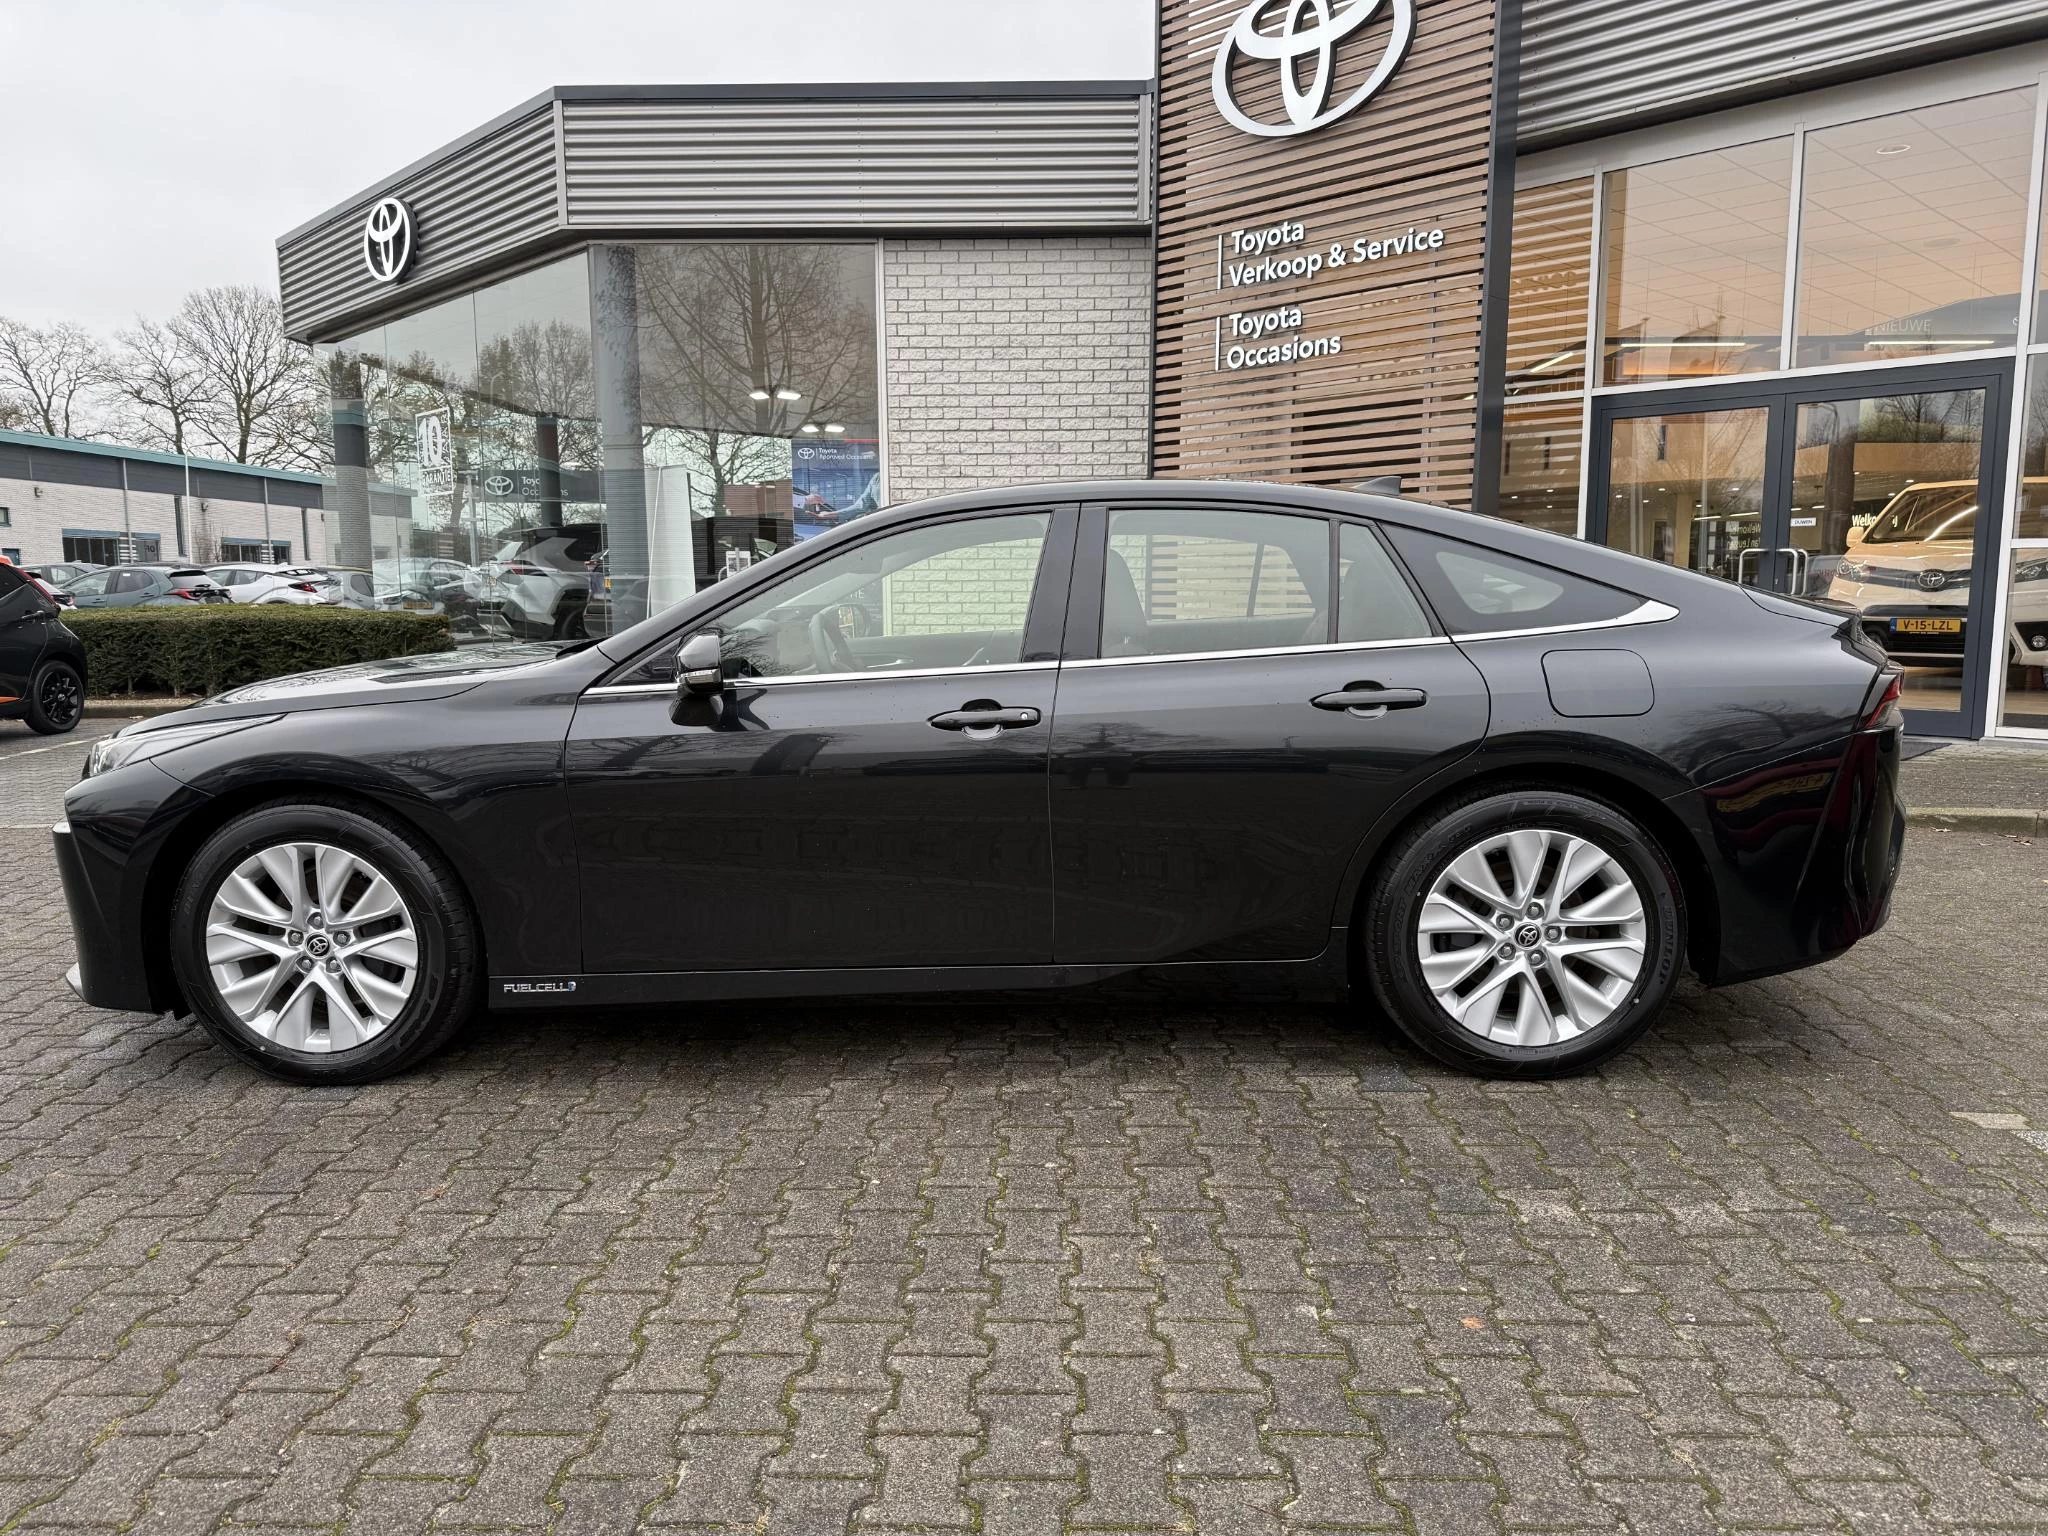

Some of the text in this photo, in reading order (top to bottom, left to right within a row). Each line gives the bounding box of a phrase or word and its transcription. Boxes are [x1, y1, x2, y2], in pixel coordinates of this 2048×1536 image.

[1231, 221, 1305, 256] Toyota
[1229, 227, 1444, 287] Verkoop & Service
[1229, 306, 1302, 338] Toyota
[1875, 319, 1932, 332] NIEUWE
[1226, 335, 1341, 369] Occasions
[418, 414, 443, 468] 10
[819, 447, 837, 455] Toyota
[521, 476, 540, 486] Toyo
[521, 487, 569, 497] Occns
[1851, 512, 1877, 527] Welko
[1903, 620, 1953, 631] V-15-LZL
[1659, 905, 1675, 985] DUNLOP
[503, 982, 568, 993] FUELCELL
